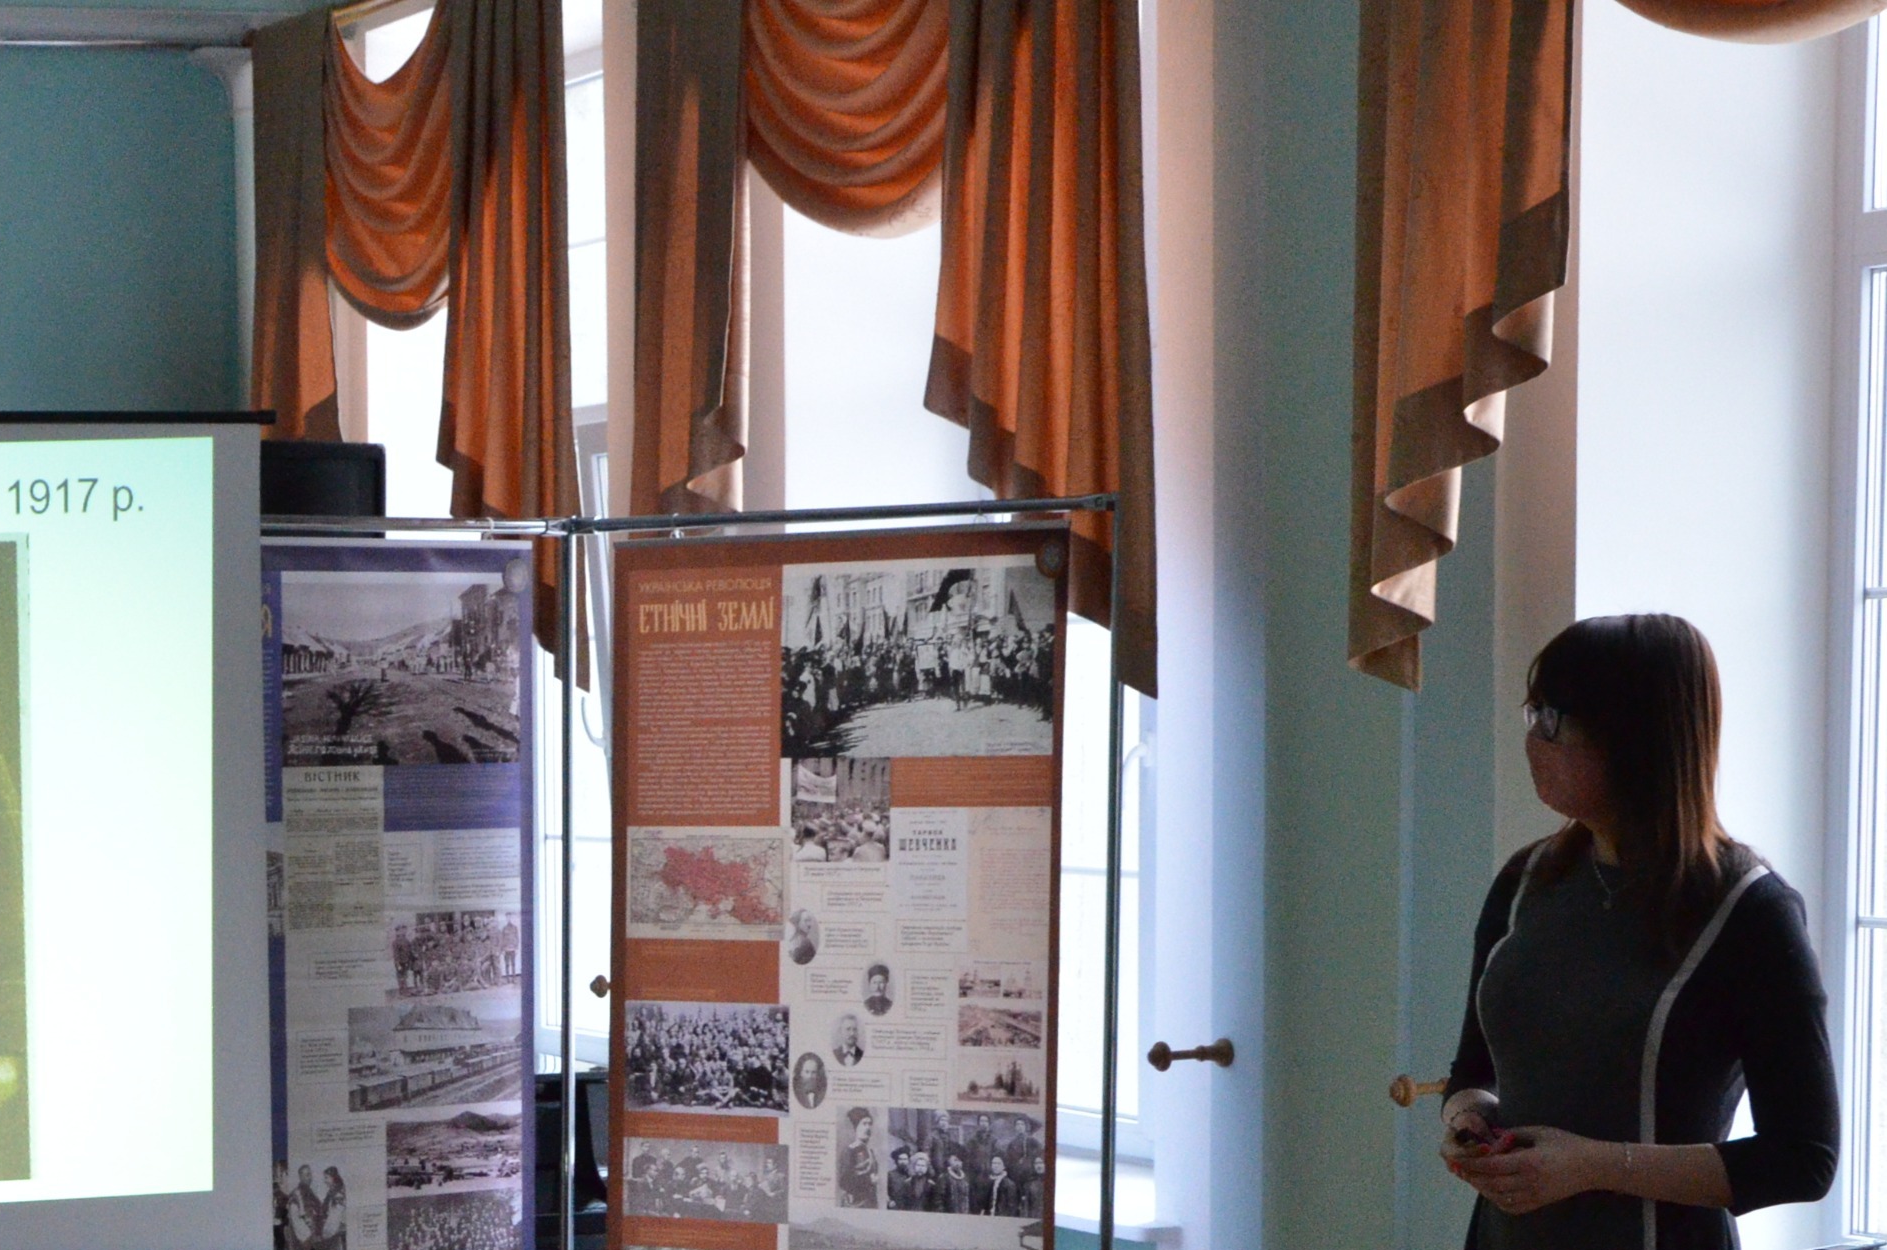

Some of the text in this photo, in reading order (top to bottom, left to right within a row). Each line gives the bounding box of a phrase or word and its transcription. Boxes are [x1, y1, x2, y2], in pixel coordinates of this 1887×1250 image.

[7, 477, 99, 515] 1917
[111, 485, 144, 522] р.
[639, 596, 774, 634] ЕТНІЧНІ ЗЕМЛІ
